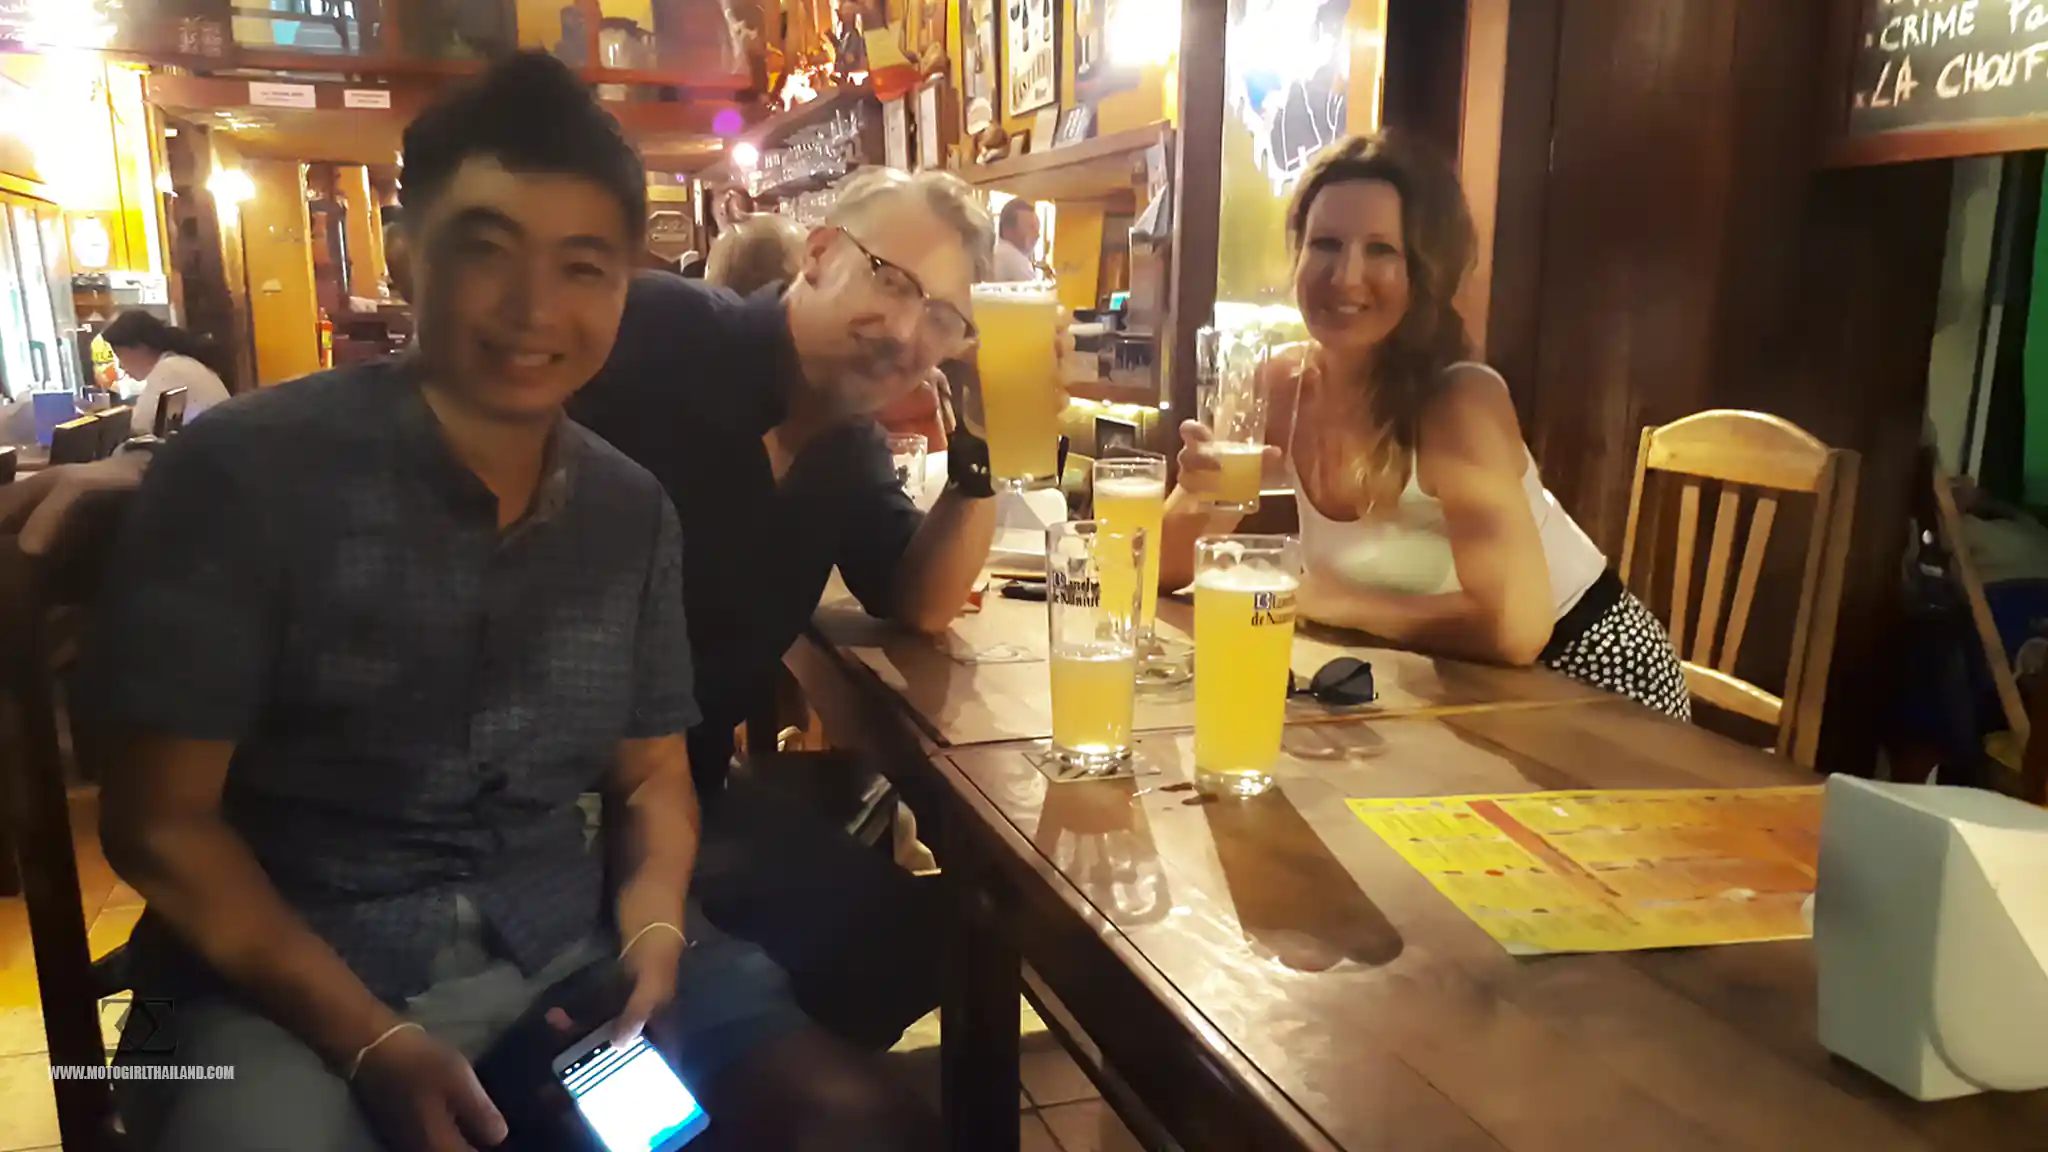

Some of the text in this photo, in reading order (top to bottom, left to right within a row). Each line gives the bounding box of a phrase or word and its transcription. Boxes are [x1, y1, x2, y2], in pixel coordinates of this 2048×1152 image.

[1880, 0, 1979, 51] CRIME
[1870, 40, 2048, 108] LA CHOUF
